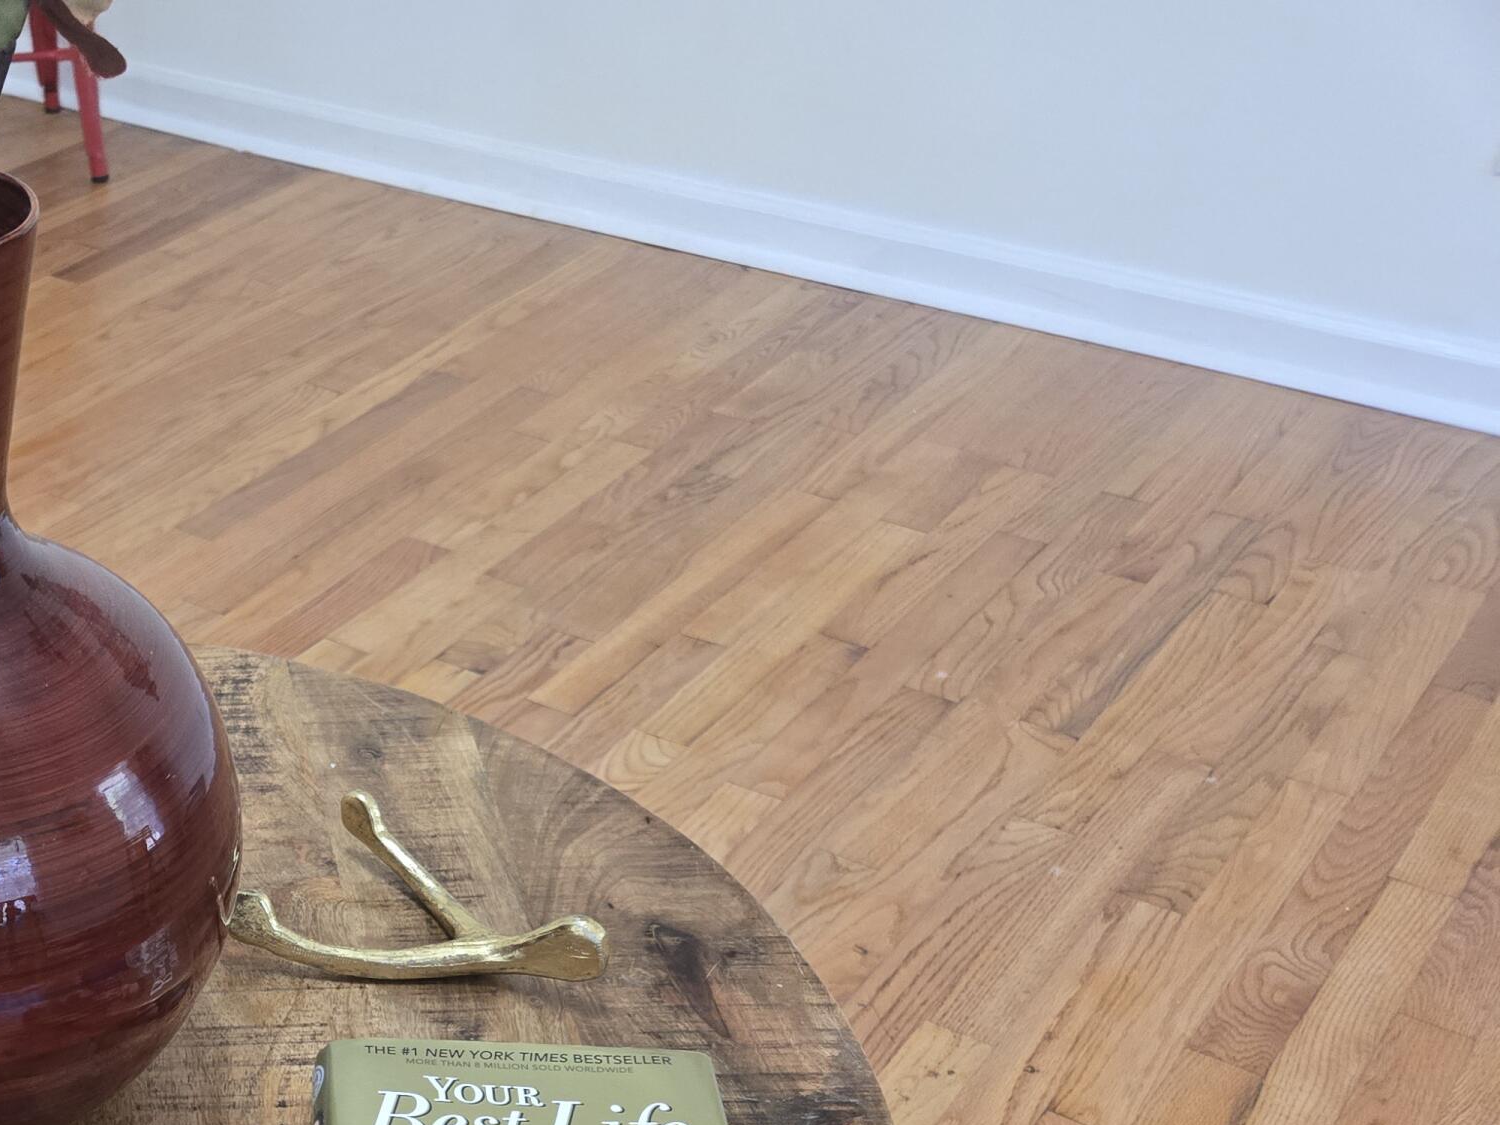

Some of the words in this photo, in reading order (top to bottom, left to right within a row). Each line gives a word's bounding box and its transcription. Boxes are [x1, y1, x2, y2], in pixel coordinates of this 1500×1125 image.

[364, 1045, 396, 1055] THE
[402, 1047, 417, 1056] #1
[426, 1048, 465, 1059] NEW
[469, 1050, 514, 1061] YORK
[520, 1052, 568, 1063] TIMES
[573, 1053, 672, 1065] BESTSELLER
[406, 1058, 439, 1066] MORE
[442, 1060, 471, 1068] THAN
[484, 1062, 529, 1071] MILLION
[531, 1064, 562, 1072] SOLD
[564, 1065, 634, 1074] WORLDWIDE
[423, 1075, 545, 1107] YOUR
